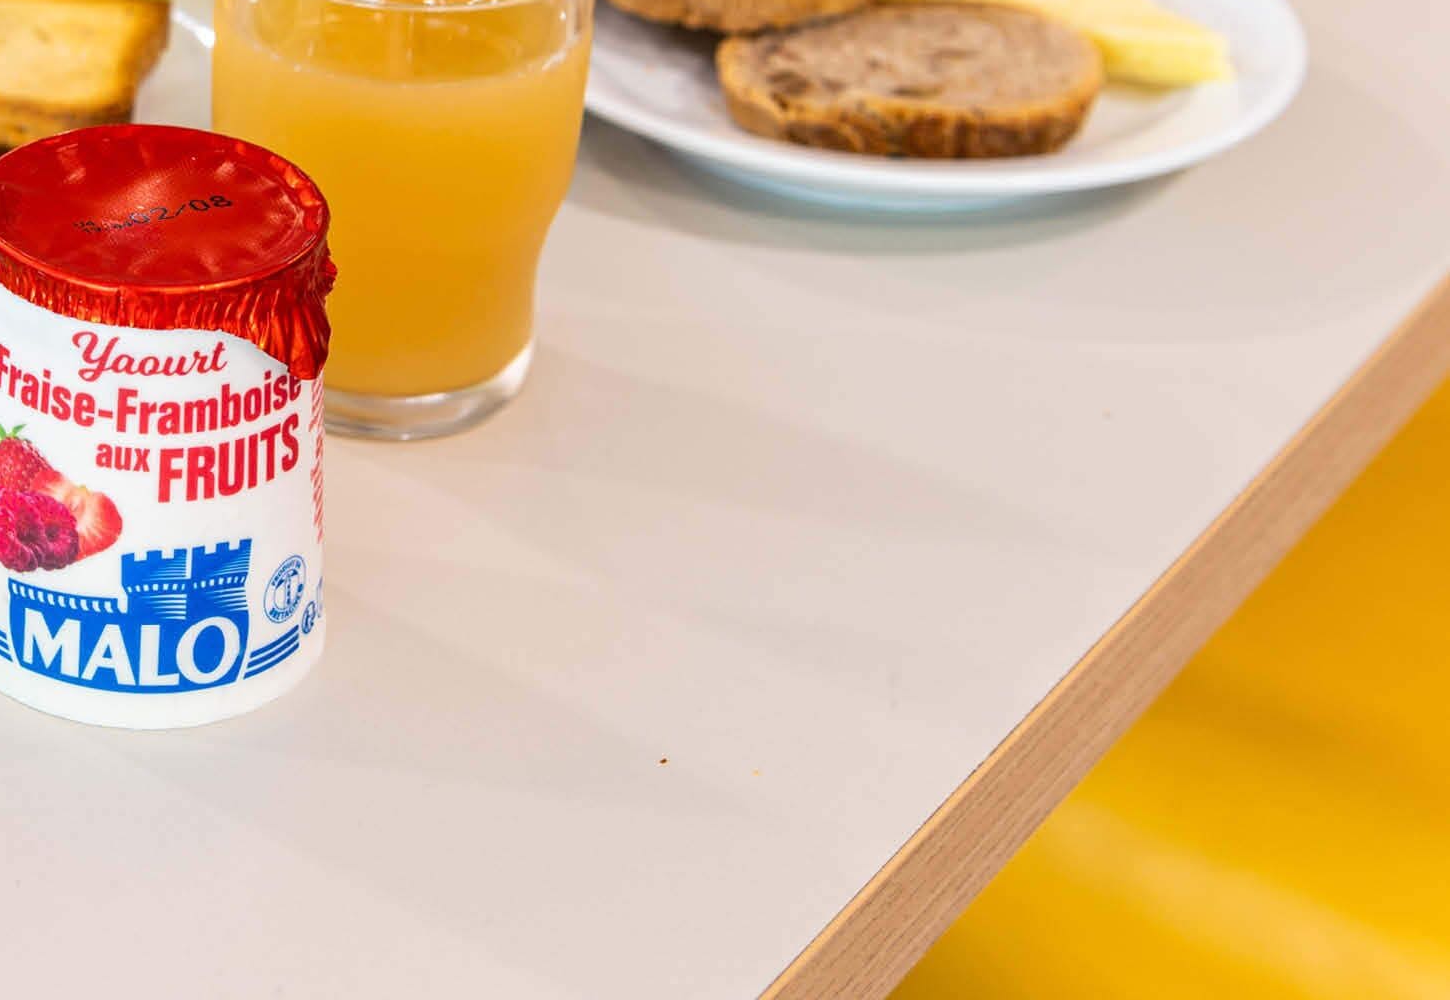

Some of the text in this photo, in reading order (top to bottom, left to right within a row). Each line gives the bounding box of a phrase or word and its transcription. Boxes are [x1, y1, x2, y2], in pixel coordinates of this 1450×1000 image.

[129, 195, 233, 224] 02/08
[72, 331, 228, 382] Yaourt
[95, 413, 299, 503] aux FRUITS
[23, 607, 242, 687] MALO
